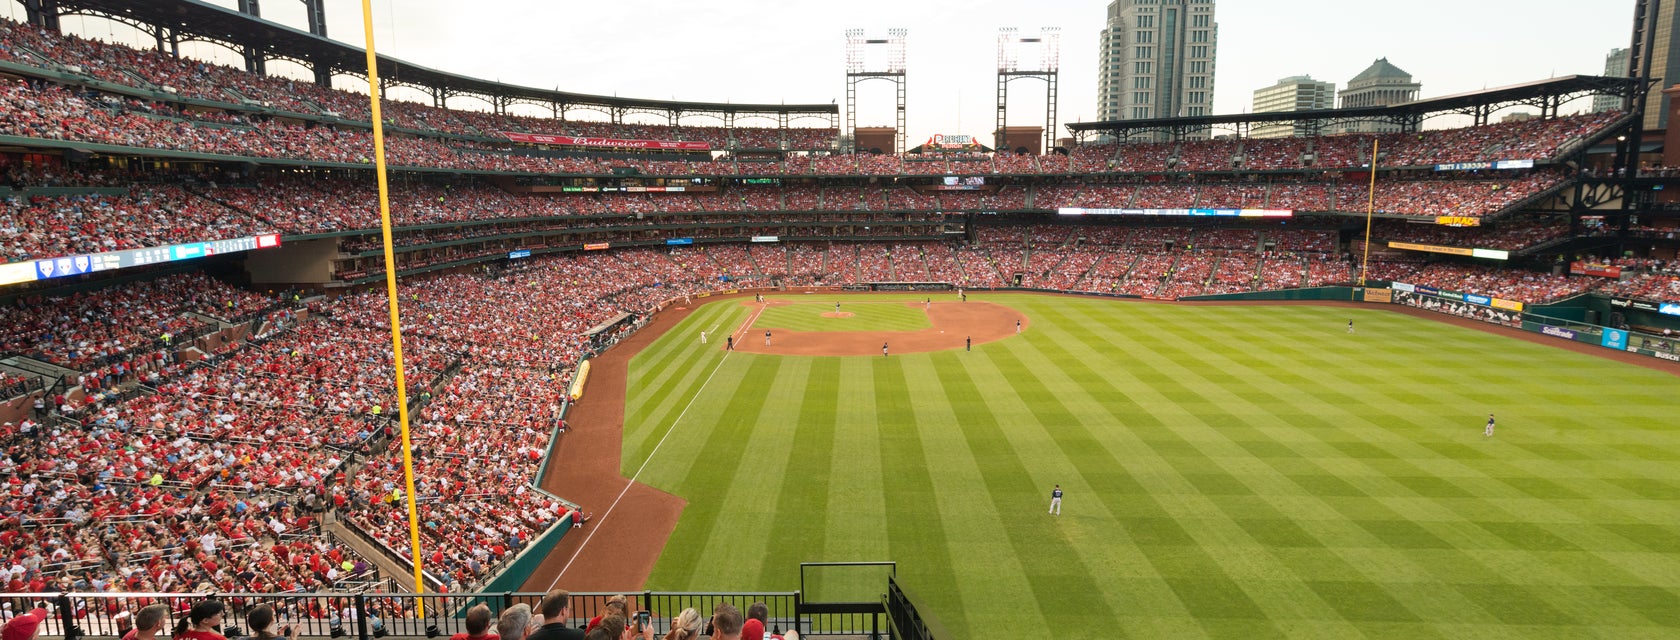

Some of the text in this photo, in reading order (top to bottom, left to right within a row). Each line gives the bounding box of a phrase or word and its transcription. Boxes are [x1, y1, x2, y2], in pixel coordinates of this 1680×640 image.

[572, 137, 648, 147] Budweiser
[1453, 216, 1474, 226] MAC
[1542, 327, 1573, 339] Scottrade
[1655, 351, 1680, 361] BUSCH
